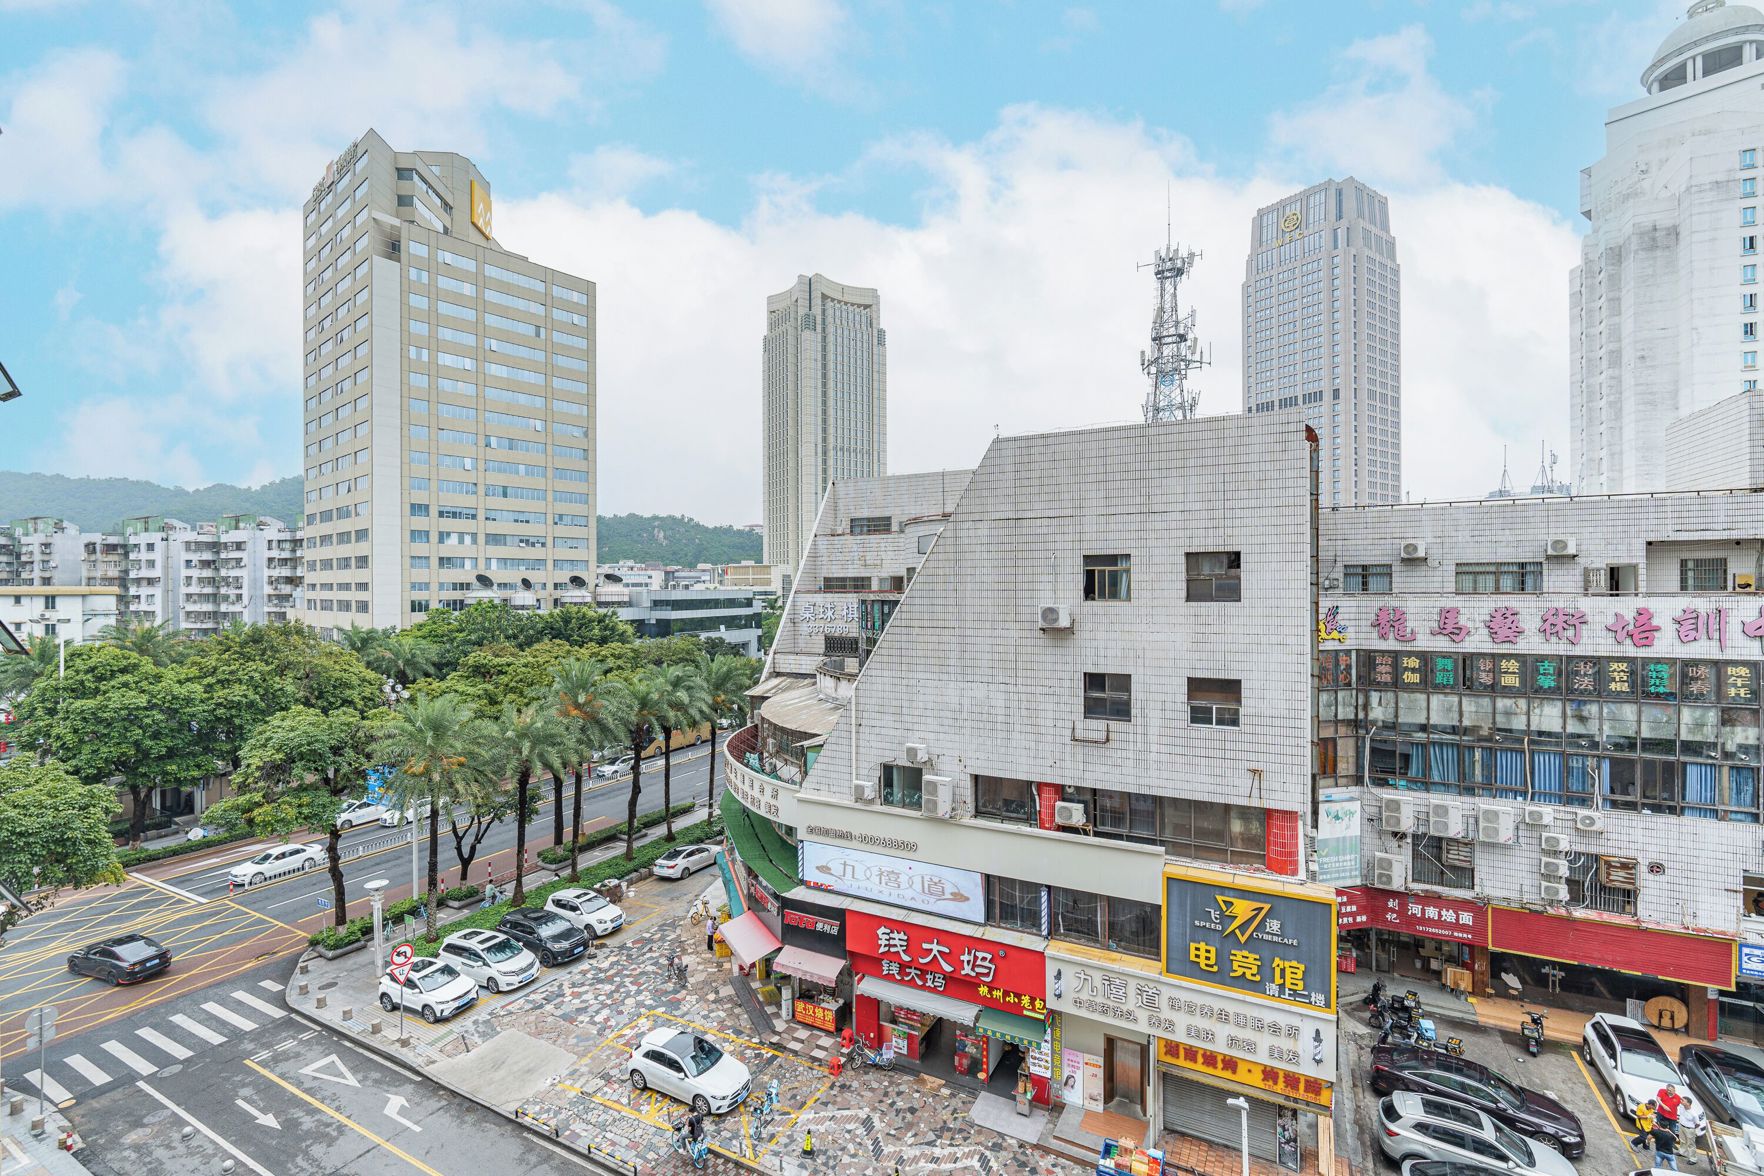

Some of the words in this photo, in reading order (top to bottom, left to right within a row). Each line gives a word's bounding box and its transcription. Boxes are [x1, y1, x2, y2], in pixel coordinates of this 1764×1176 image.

[800, 602, 836, 622] 桌球
[1402, 656, 1420, 684] 瑜伽
[1436, 657, 1454, 685] 舞蹈
[1478, 659, 1494, 686] 钢琴
[1500, 660, 1520, 687] 绘画
[1536, 660, 1556, 689] 古筝
[1574, 662, 1594, 690] 书法
[1608, 662, 1630, 692] 双节棍
[1688, 665, 1711, 694] 咏春
[1728, 666, 1751, 698] 晚午托
[840, 860, 946, 898] 九禧道
[816, 922, 839, 935] 便利店
[1194, 920, 1222, 930] SPEED
[1205, 908, 1220, 924] 飞
[1265, 918, 1281, 935] 速
[1408, 904, 1473, 926] 河南烩面
[876, 926, 996, 982] 钱大妈
[1190, 941, 1305, 991] 电竞馆
[882, 960, 946, 991] 钱大妈
[978, 984, 1046, 1013] 杭州小笼包
[1074, 970, 1162, 1012] 九禧道
[1168, 996, 1300, 1040] 禅疗养生睡眠会所
[1265, 982, 1326, 1008] 请上二楼
[796, 1002, 833, 1022] 武汉烧饼
[1072, 997, 1138, 1024] 中草药洗头
[1148, 1014, 1176, 1033] 养发
[1186, 1024, 1215, 1044] 美肤
[1227, 1034, 1256, 1054] 抗衰
[1268, 1044, 1300, 1065] 美发
